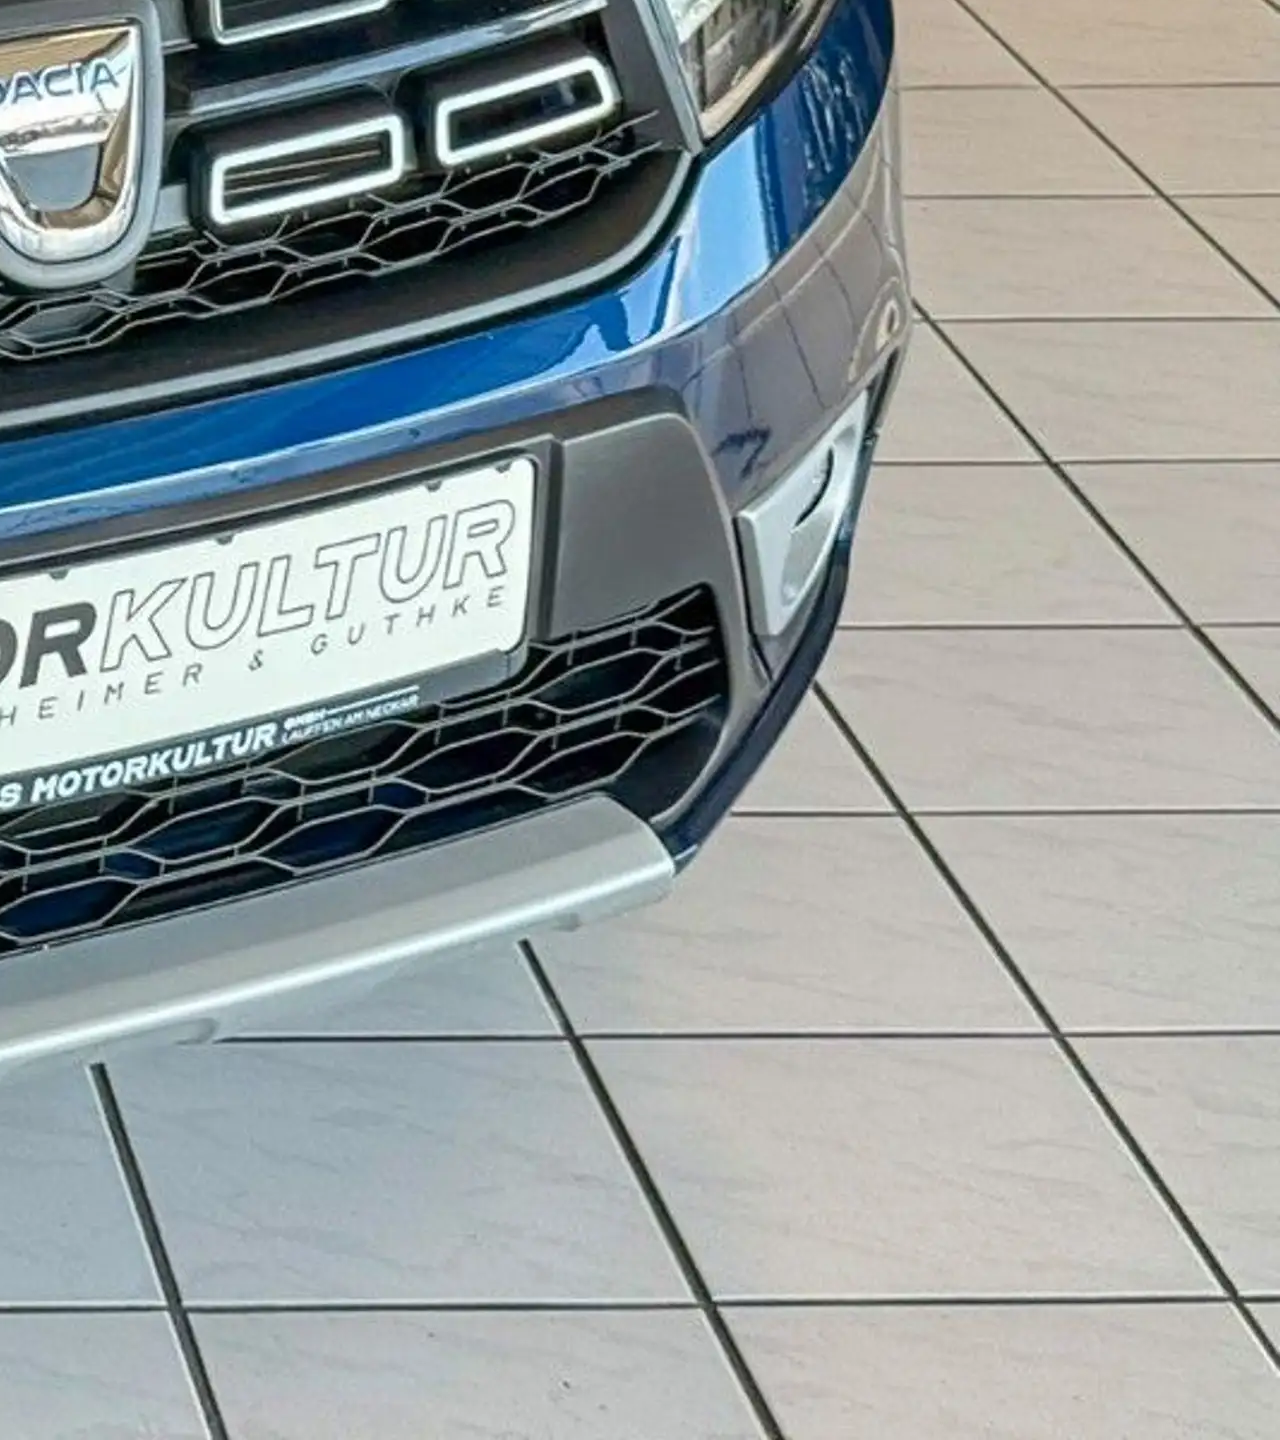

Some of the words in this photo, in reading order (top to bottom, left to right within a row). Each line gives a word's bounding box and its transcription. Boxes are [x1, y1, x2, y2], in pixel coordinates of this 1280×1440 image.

[248, 650, 264, 672] &
[311, 586, 504, 656] GUTHKE
[31, 722, 277, 803] MOTORKULTUR
